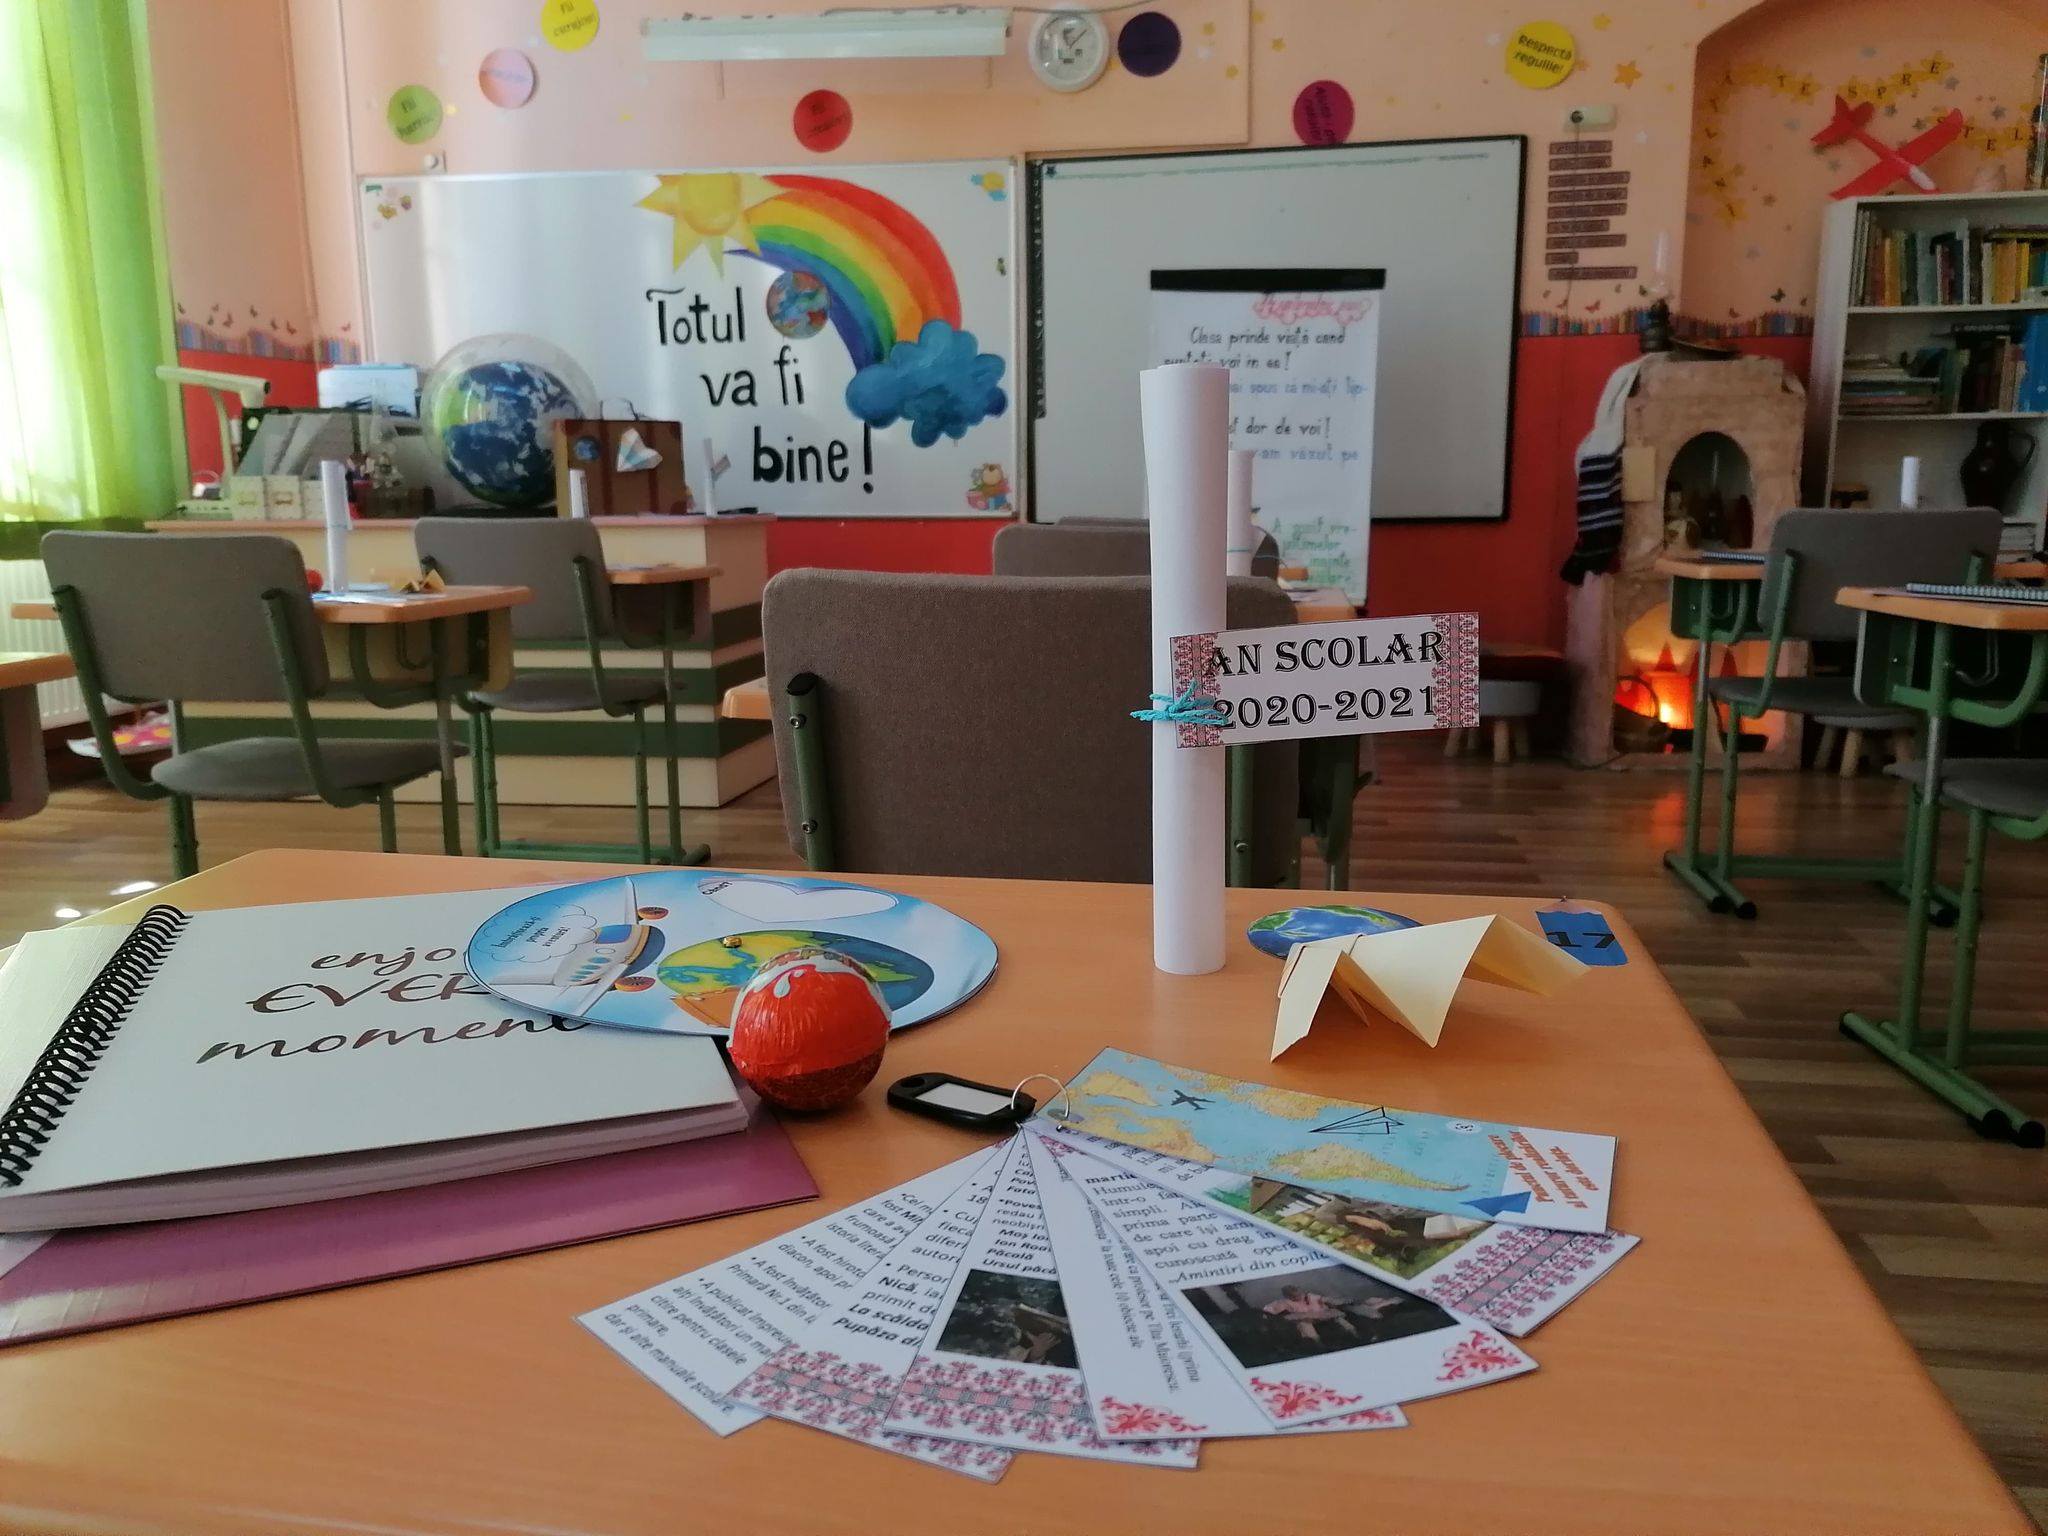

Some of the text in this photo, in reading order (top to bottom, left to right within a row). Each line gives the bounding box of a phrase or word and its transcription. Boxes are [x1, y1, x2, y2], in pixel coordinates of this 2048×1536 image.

[646, 286, 746, 346] Totul
[1228, 325, 1270, 350] prinde
[699, 344, 806, 407] va fi
[1246, 416, 1269, 434] dor
[1275, 416, 1291, 435] de
[753, 422, 873, 494] bine!
[1204, 631, 1446, 678] AN SCOLAR
[1214, 685, 1435, 730] 2020-2021
[1546, 932, 1617, 950] 17
[311, 946, 465, 977] enjo
[245, 971, 505, 1014] EVER
[863, 1207, 888, 1222] care
[881, 1199, 904, 1214] fost
[1122, 1219, 1170, 1233] prima
[1133, 1233, 1153, 1243] de
[1159, 1229, 1193, 1240] care
[1188, 1240, 1208, 1250] cu
[1215, 1235, 1255, 1248] drag
[813, 1243, 837, 1259] fost
[763, 1263, 787, 1281] fost
[848, 1303, 870, 1316] La
